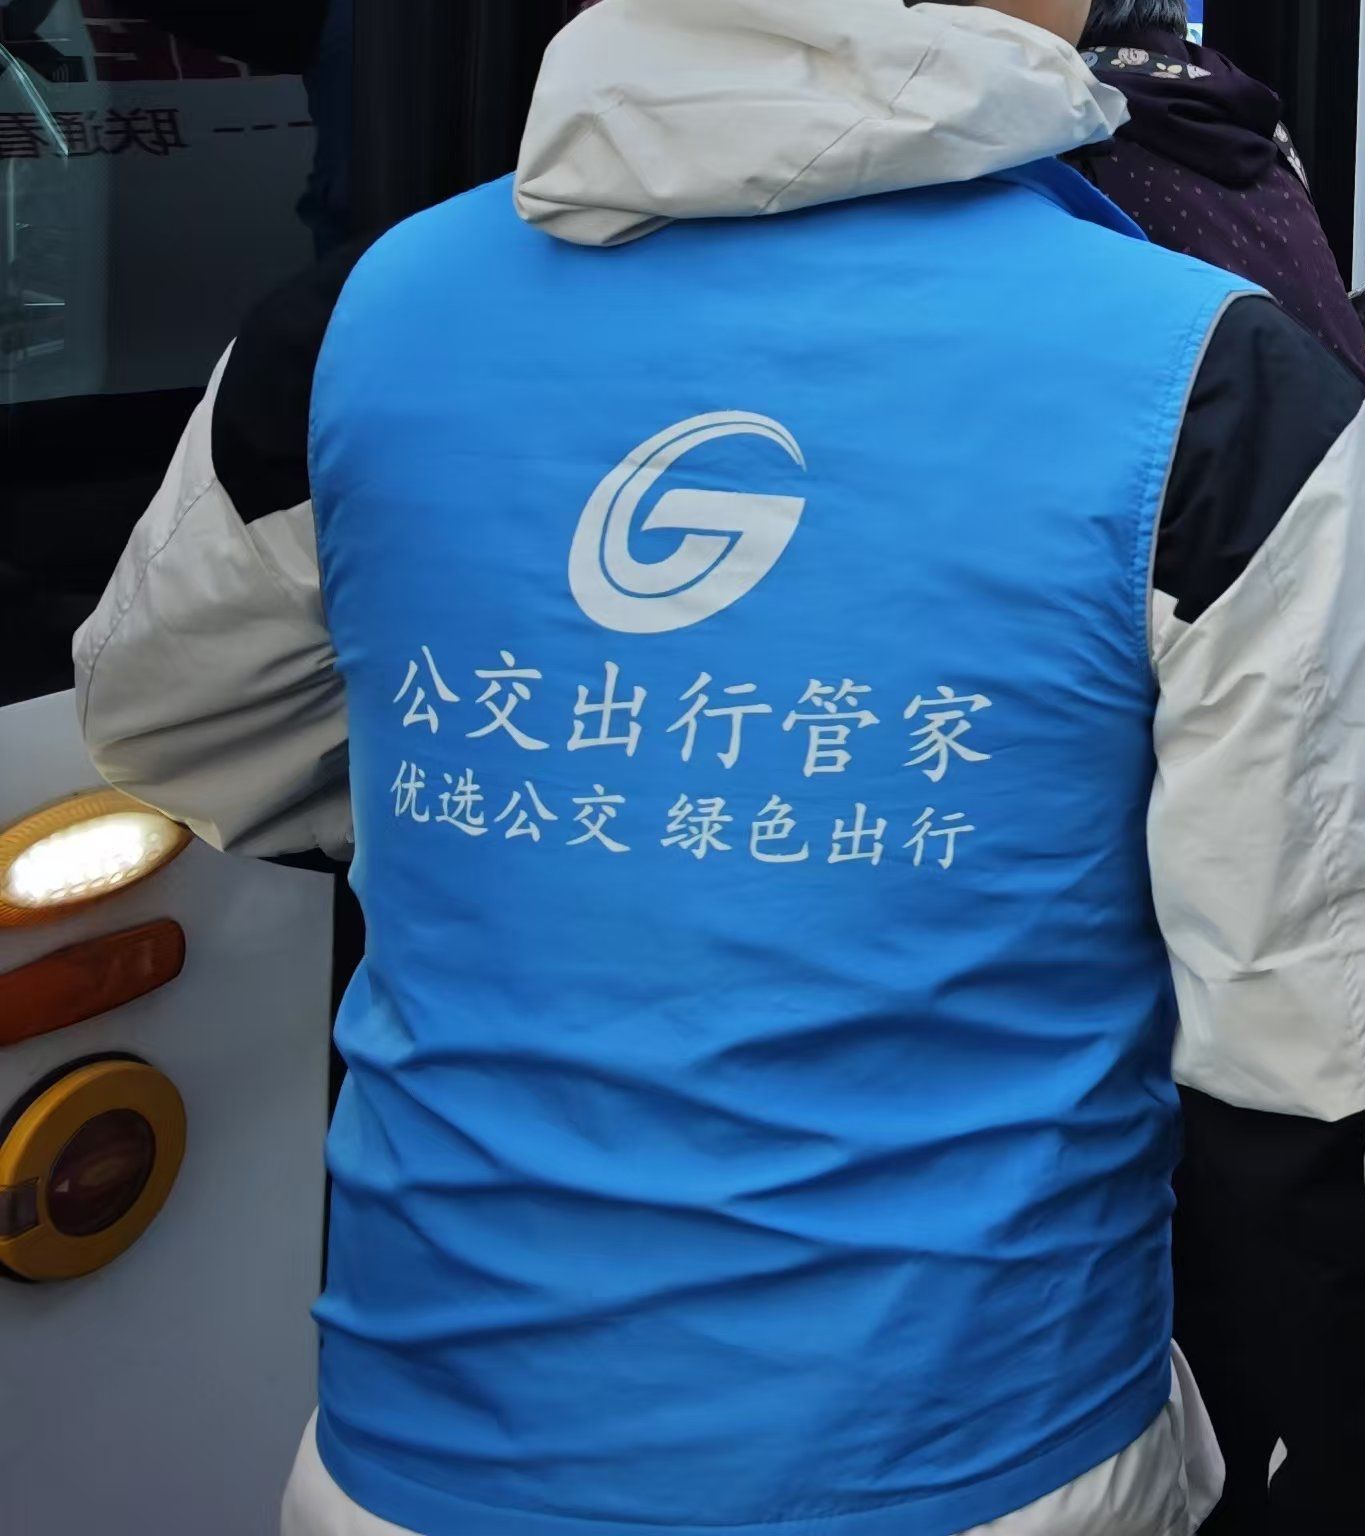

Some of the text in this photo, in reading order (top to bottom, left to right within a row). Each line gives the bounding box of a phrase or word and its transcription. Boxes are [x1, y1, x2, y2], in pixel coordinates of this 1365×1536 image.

[391, 645, 994, 783] 公交出行管家
[388, 760, 977, 869] 优选公交 绿色出行
